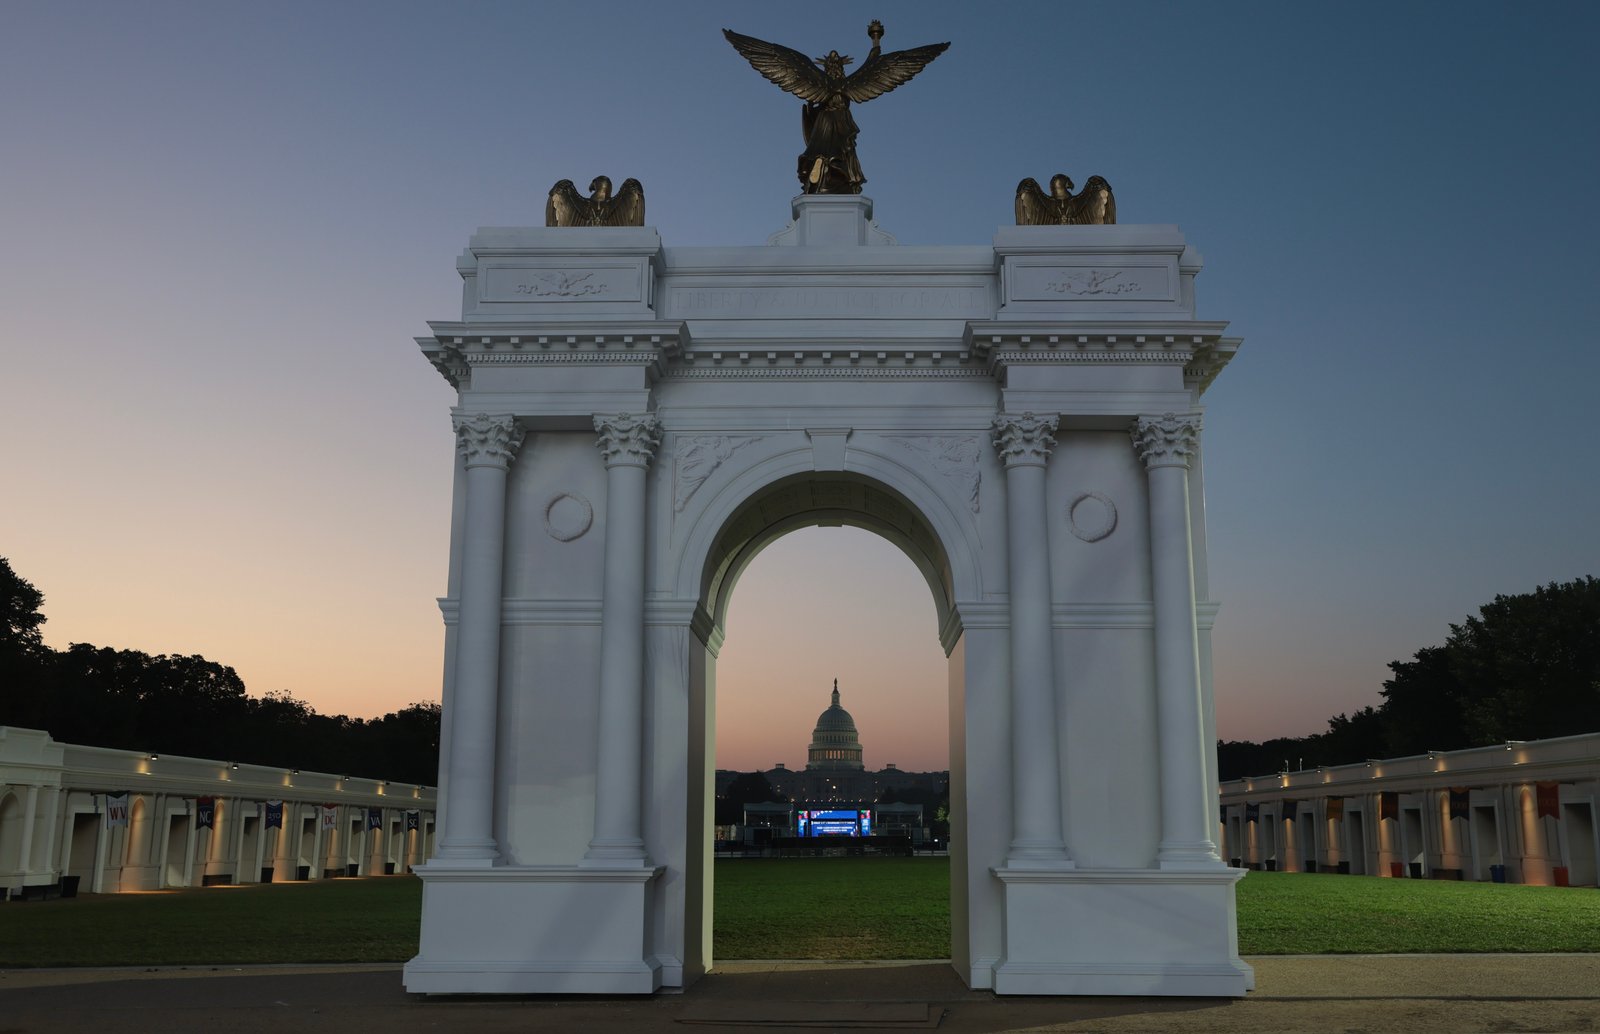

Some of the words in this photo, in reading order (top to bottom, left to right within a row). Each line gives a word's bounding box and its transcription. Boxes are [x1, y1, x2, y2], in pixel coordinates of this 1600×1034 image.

[676, 292, 763, 309] LIBERTY
[769, 292, 785, 308] &
[794, 292, 880, 309] JUTICE
[889, 291, 934, 309] FOR
[940, 292, 981, 309] ALL
[109, 806, 127, 821] WV
[199, 811, 212, 823] NC
[268, 812, 281, 822] 250
[324, 814, 335, 825] DC
[370, 816, 381, 826] VA
[409, 818, 417, 828] SC
